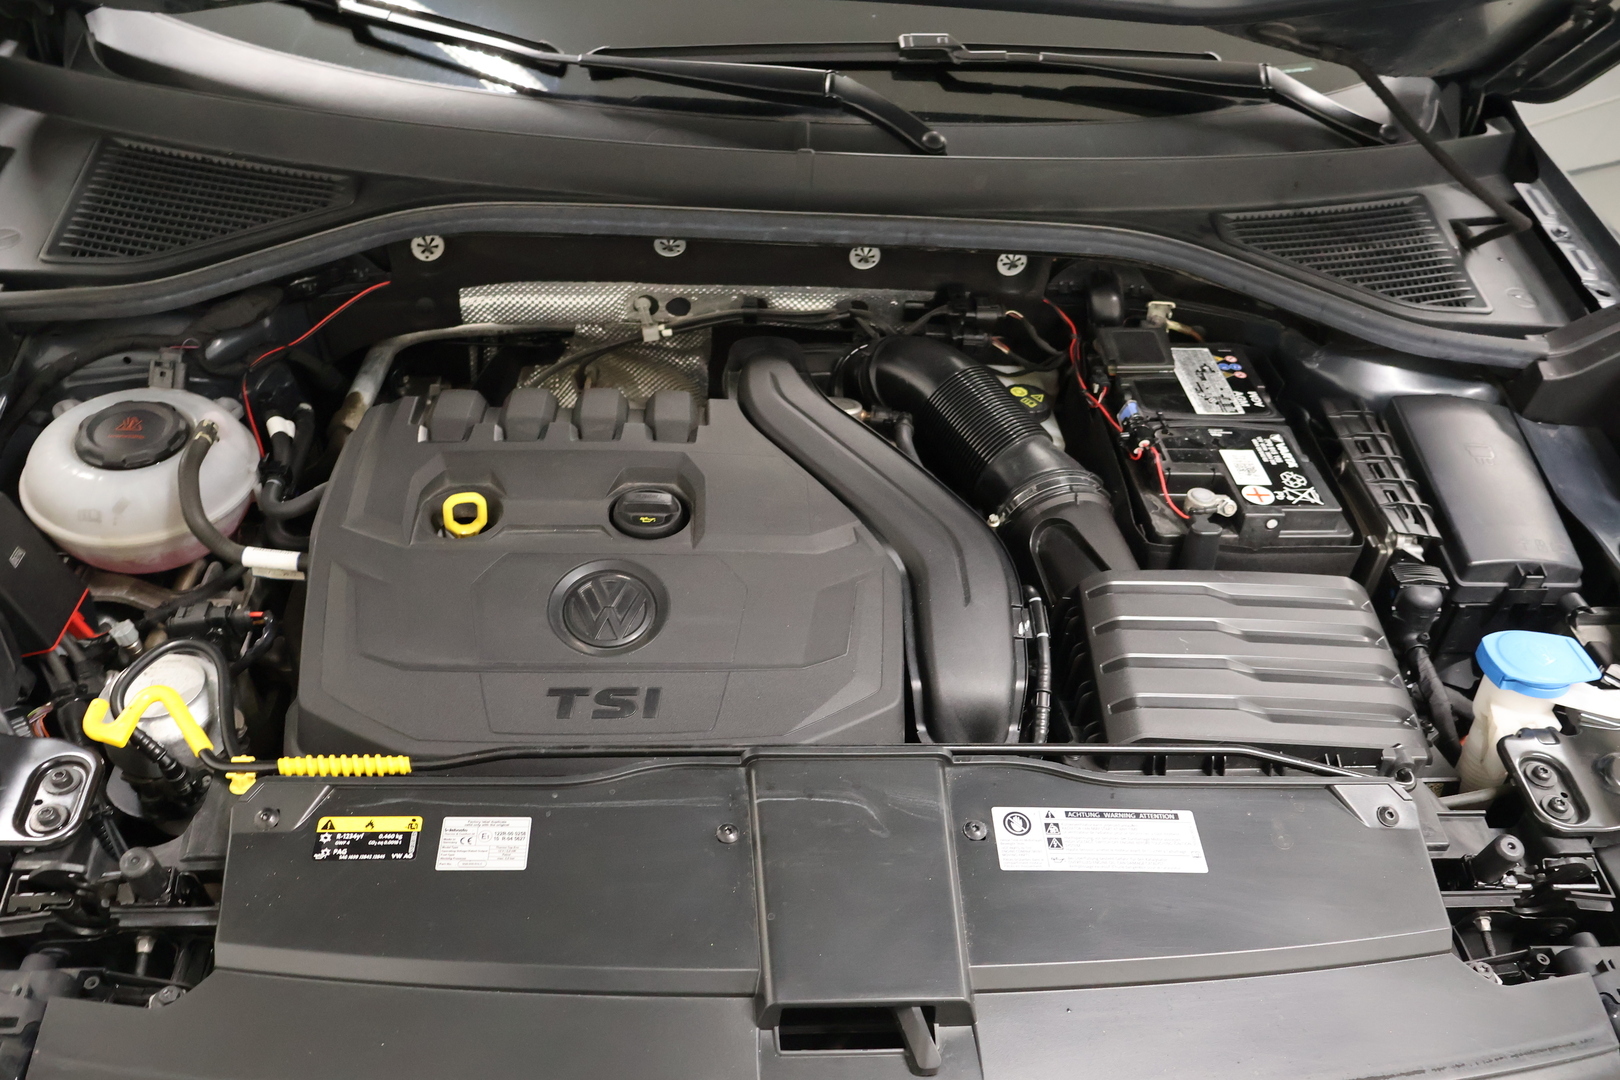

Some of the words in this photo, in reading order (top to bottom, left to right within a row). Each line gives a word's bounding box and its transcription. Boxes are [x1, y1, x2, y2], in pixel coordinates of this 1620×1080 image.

[1275, 442, 1298, 468] VARTA
[546, 687, 662, 719] TSI
[336, 833, 365, 841] R-1234yf
